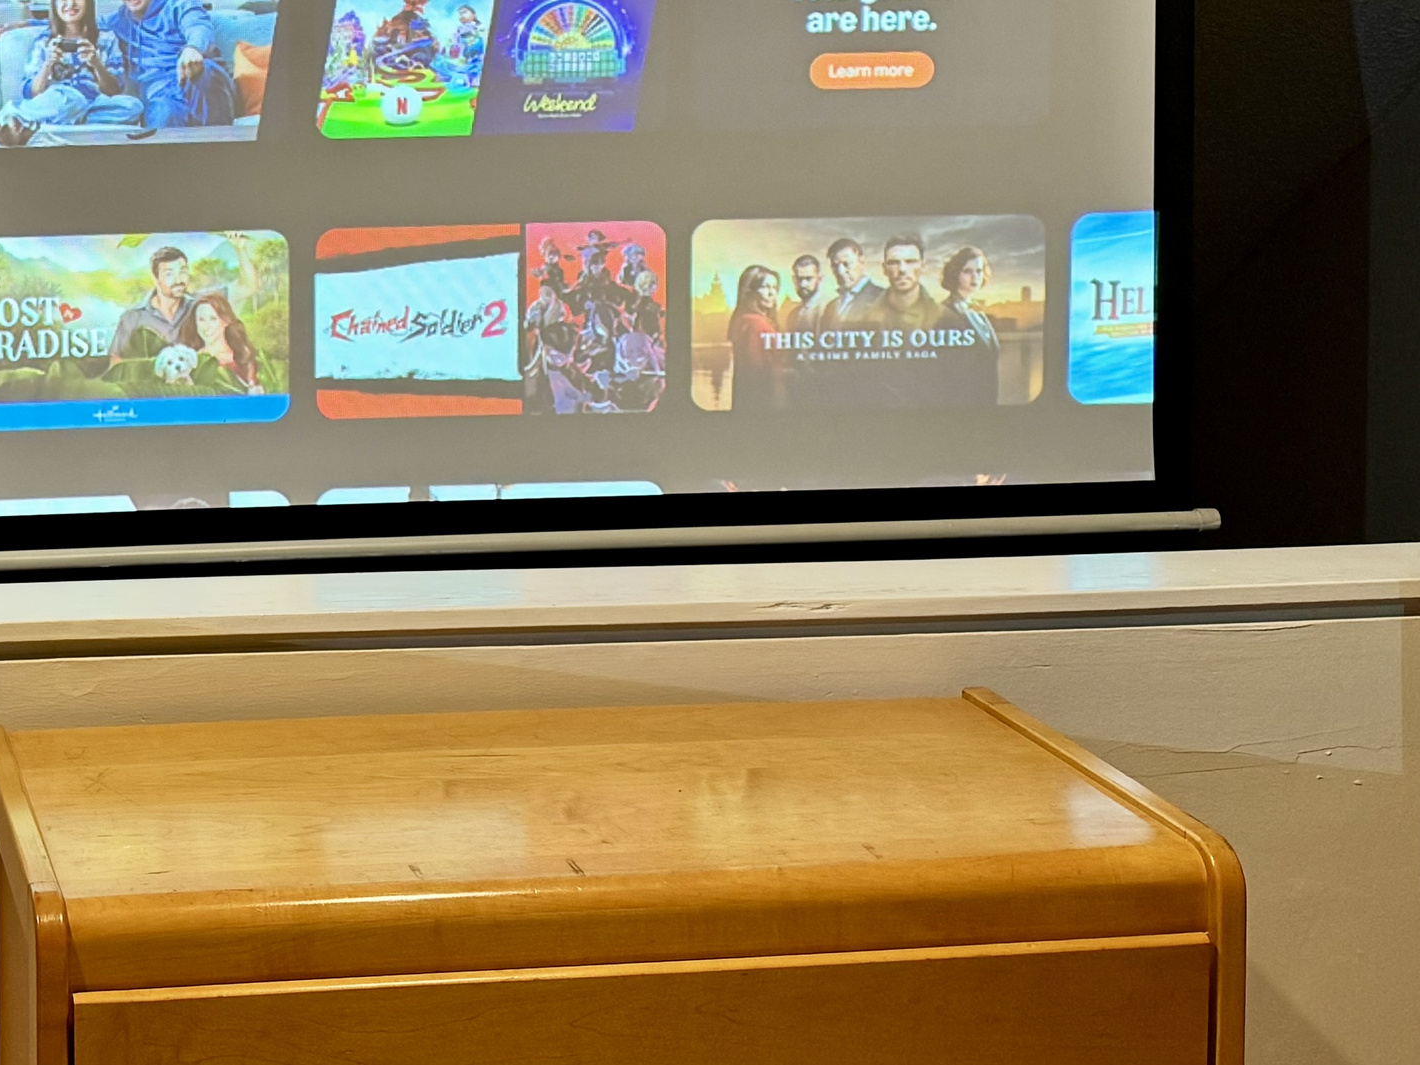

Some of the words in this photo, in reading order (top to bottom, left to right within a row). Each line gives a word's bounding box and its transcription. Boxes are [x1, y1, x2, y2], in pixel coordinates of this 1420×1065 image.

[806, 11, 858, 33] are
[861, 6, 937, 32] here.
[828, 63, 872, 79] Learn
[874, 64, 915, 78] more
[330, 305, 410, 342] Chained
[399, 309, 483, 343] Soldier
[481, 299, 508, 338] 2
[760, 330, 814, 350] THIS
[818, 330, 875, 349] CITY
[882, 329, 904, 348] IS
[910, 328, 976, 347] OURS
[796, 353, 805, 361] A
